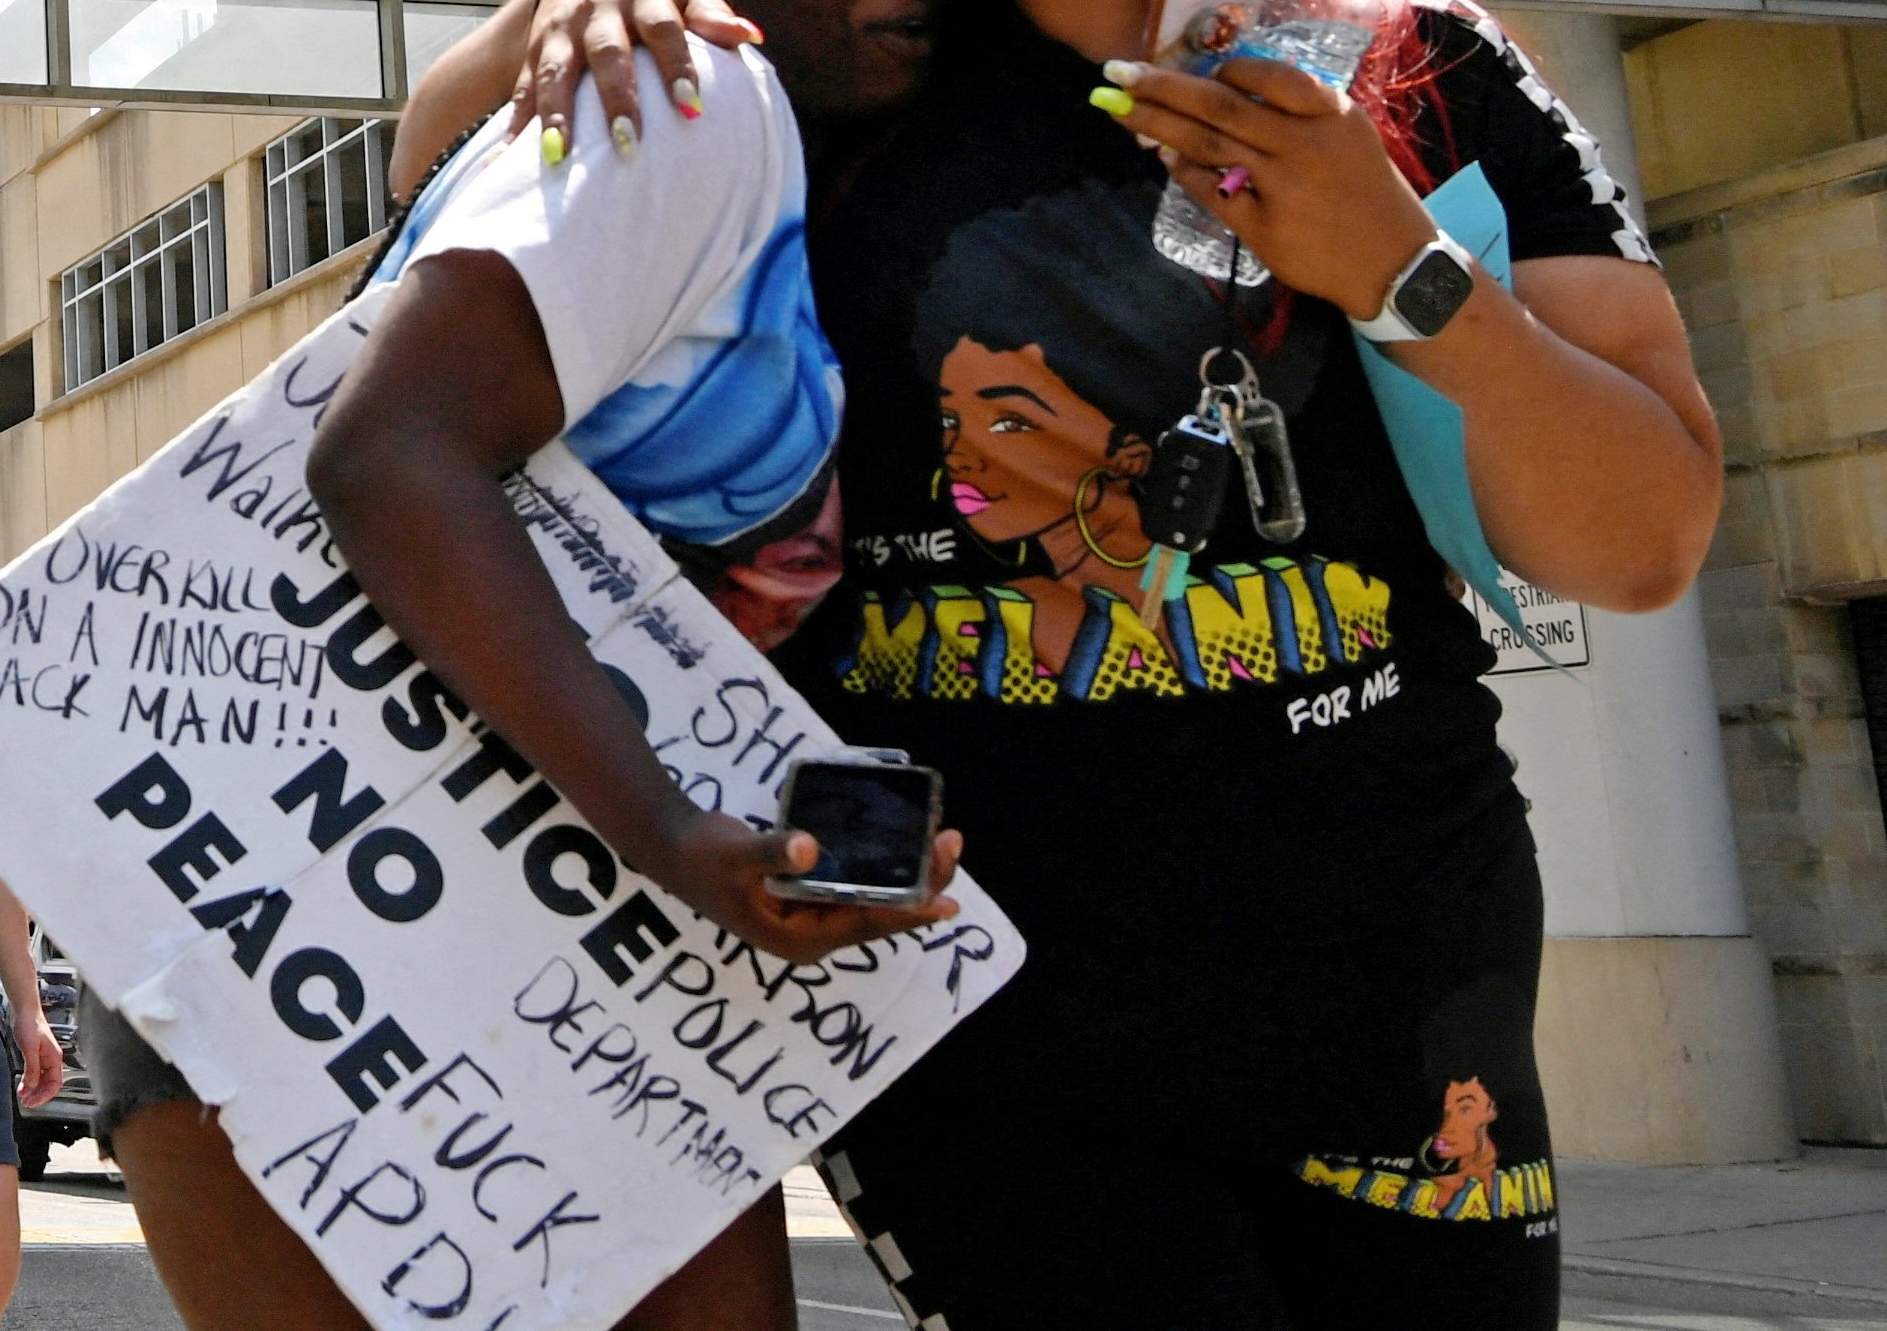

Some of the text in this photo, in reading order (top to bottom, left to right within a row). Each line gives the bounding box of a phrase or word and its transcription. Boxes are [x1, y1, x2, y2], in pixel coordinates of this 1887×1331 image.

[894, 528, 958, 562] THE
[69, 600, 100, 666] A
[129, 611, 328, 699] INNOCENT
[1285, 662, 1403, 735] FOR ME
[270, 570, 681, 988] JUSTICE
[270, 746, 445, 924] NO
[94, 750, 430, 1115] PEACE
[633, 950, 838, 1138] POLICE
[400, 1052, 601, 1289] FUCK
